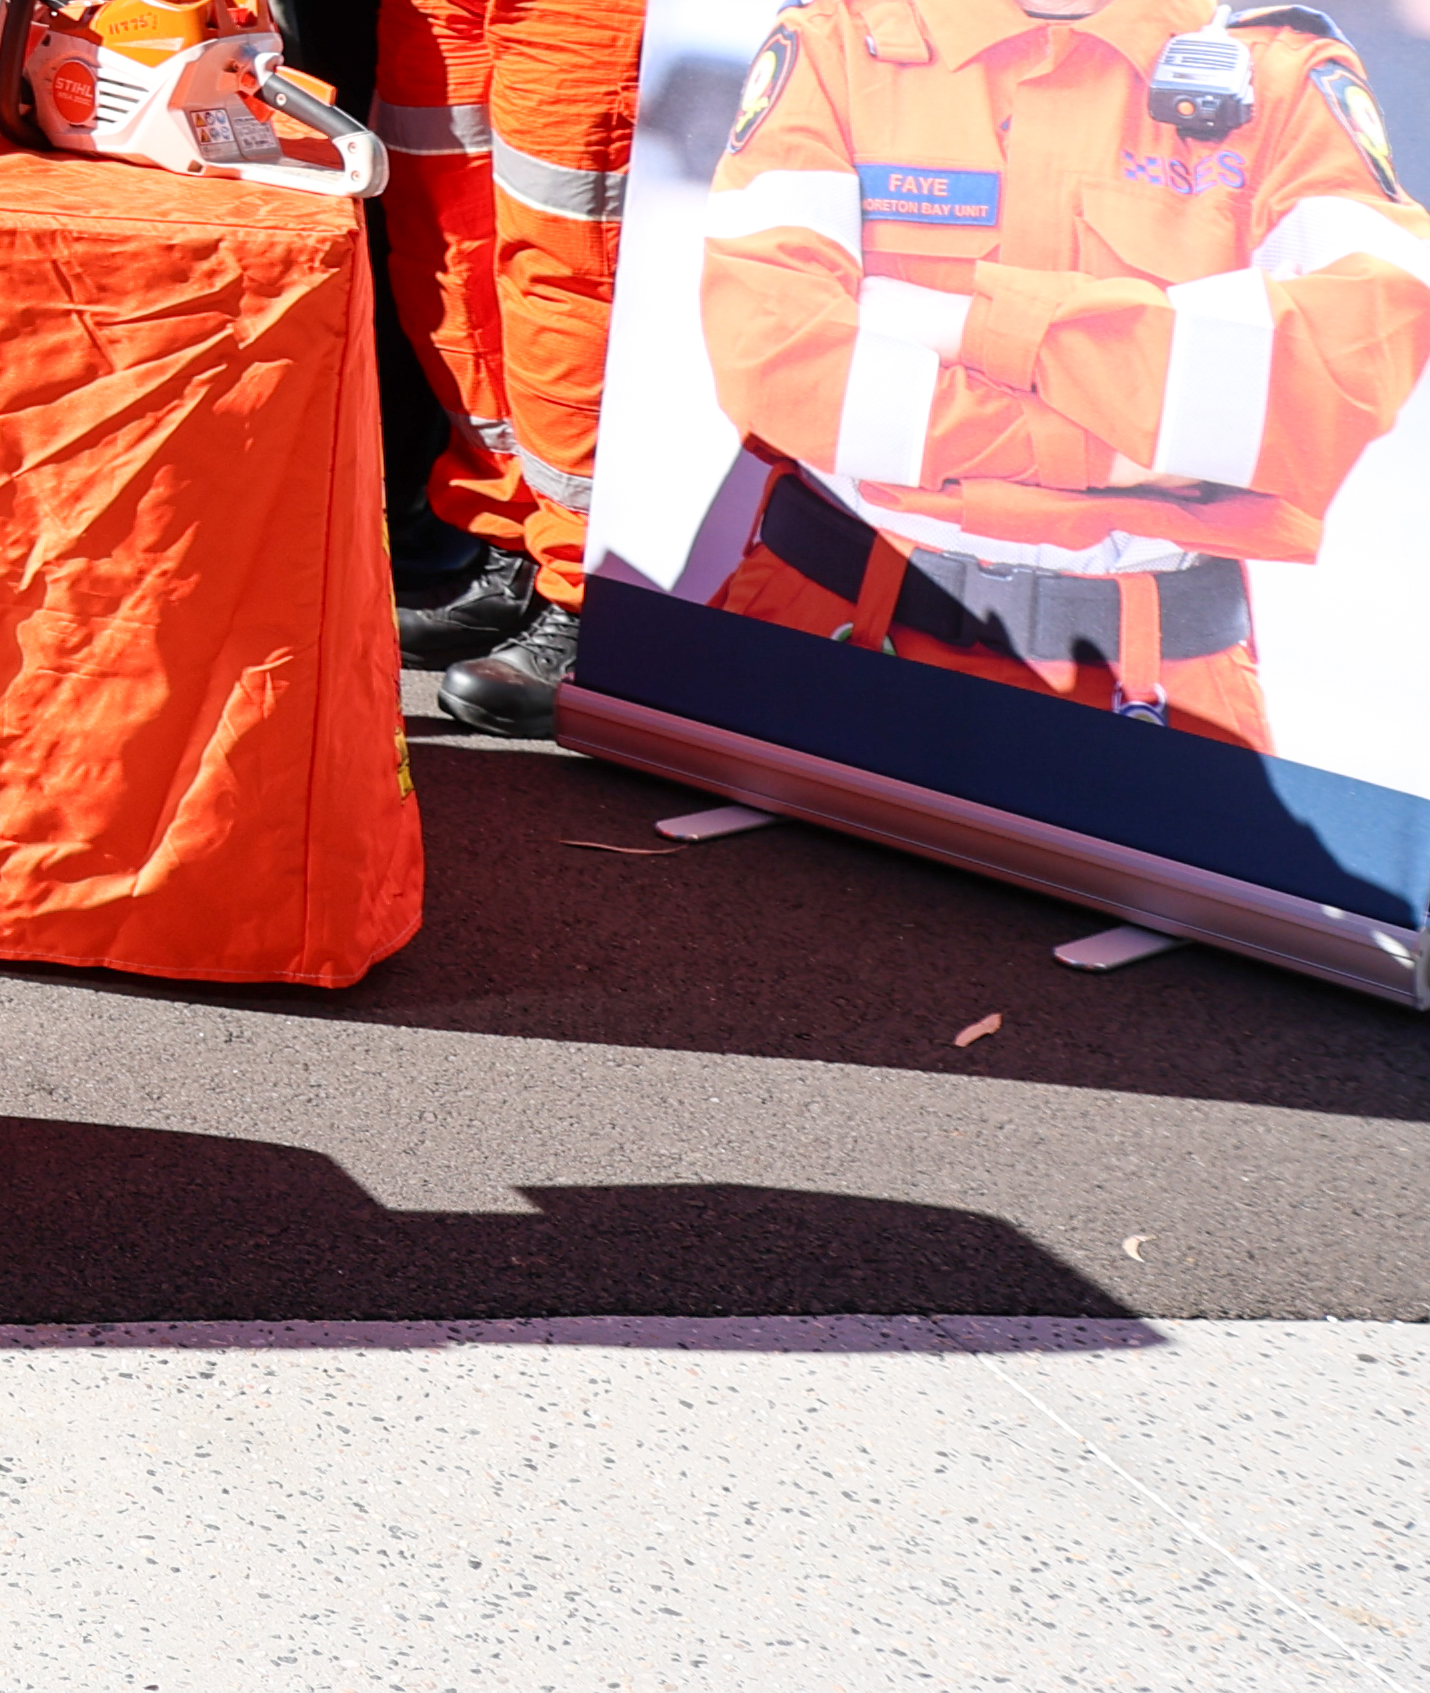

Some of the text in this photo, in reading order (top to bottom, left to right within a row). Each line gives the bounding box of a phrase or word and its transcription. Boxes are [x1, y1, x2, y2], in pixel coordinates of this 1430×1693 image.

[55, 77, 94, 98] STIHL
[1170, 151, 1246, 195] SES
[889, 174, 949, 196] FAYE
[920, 200, 952, 215] BAY
[954, 204, 989, 218] UNIT
